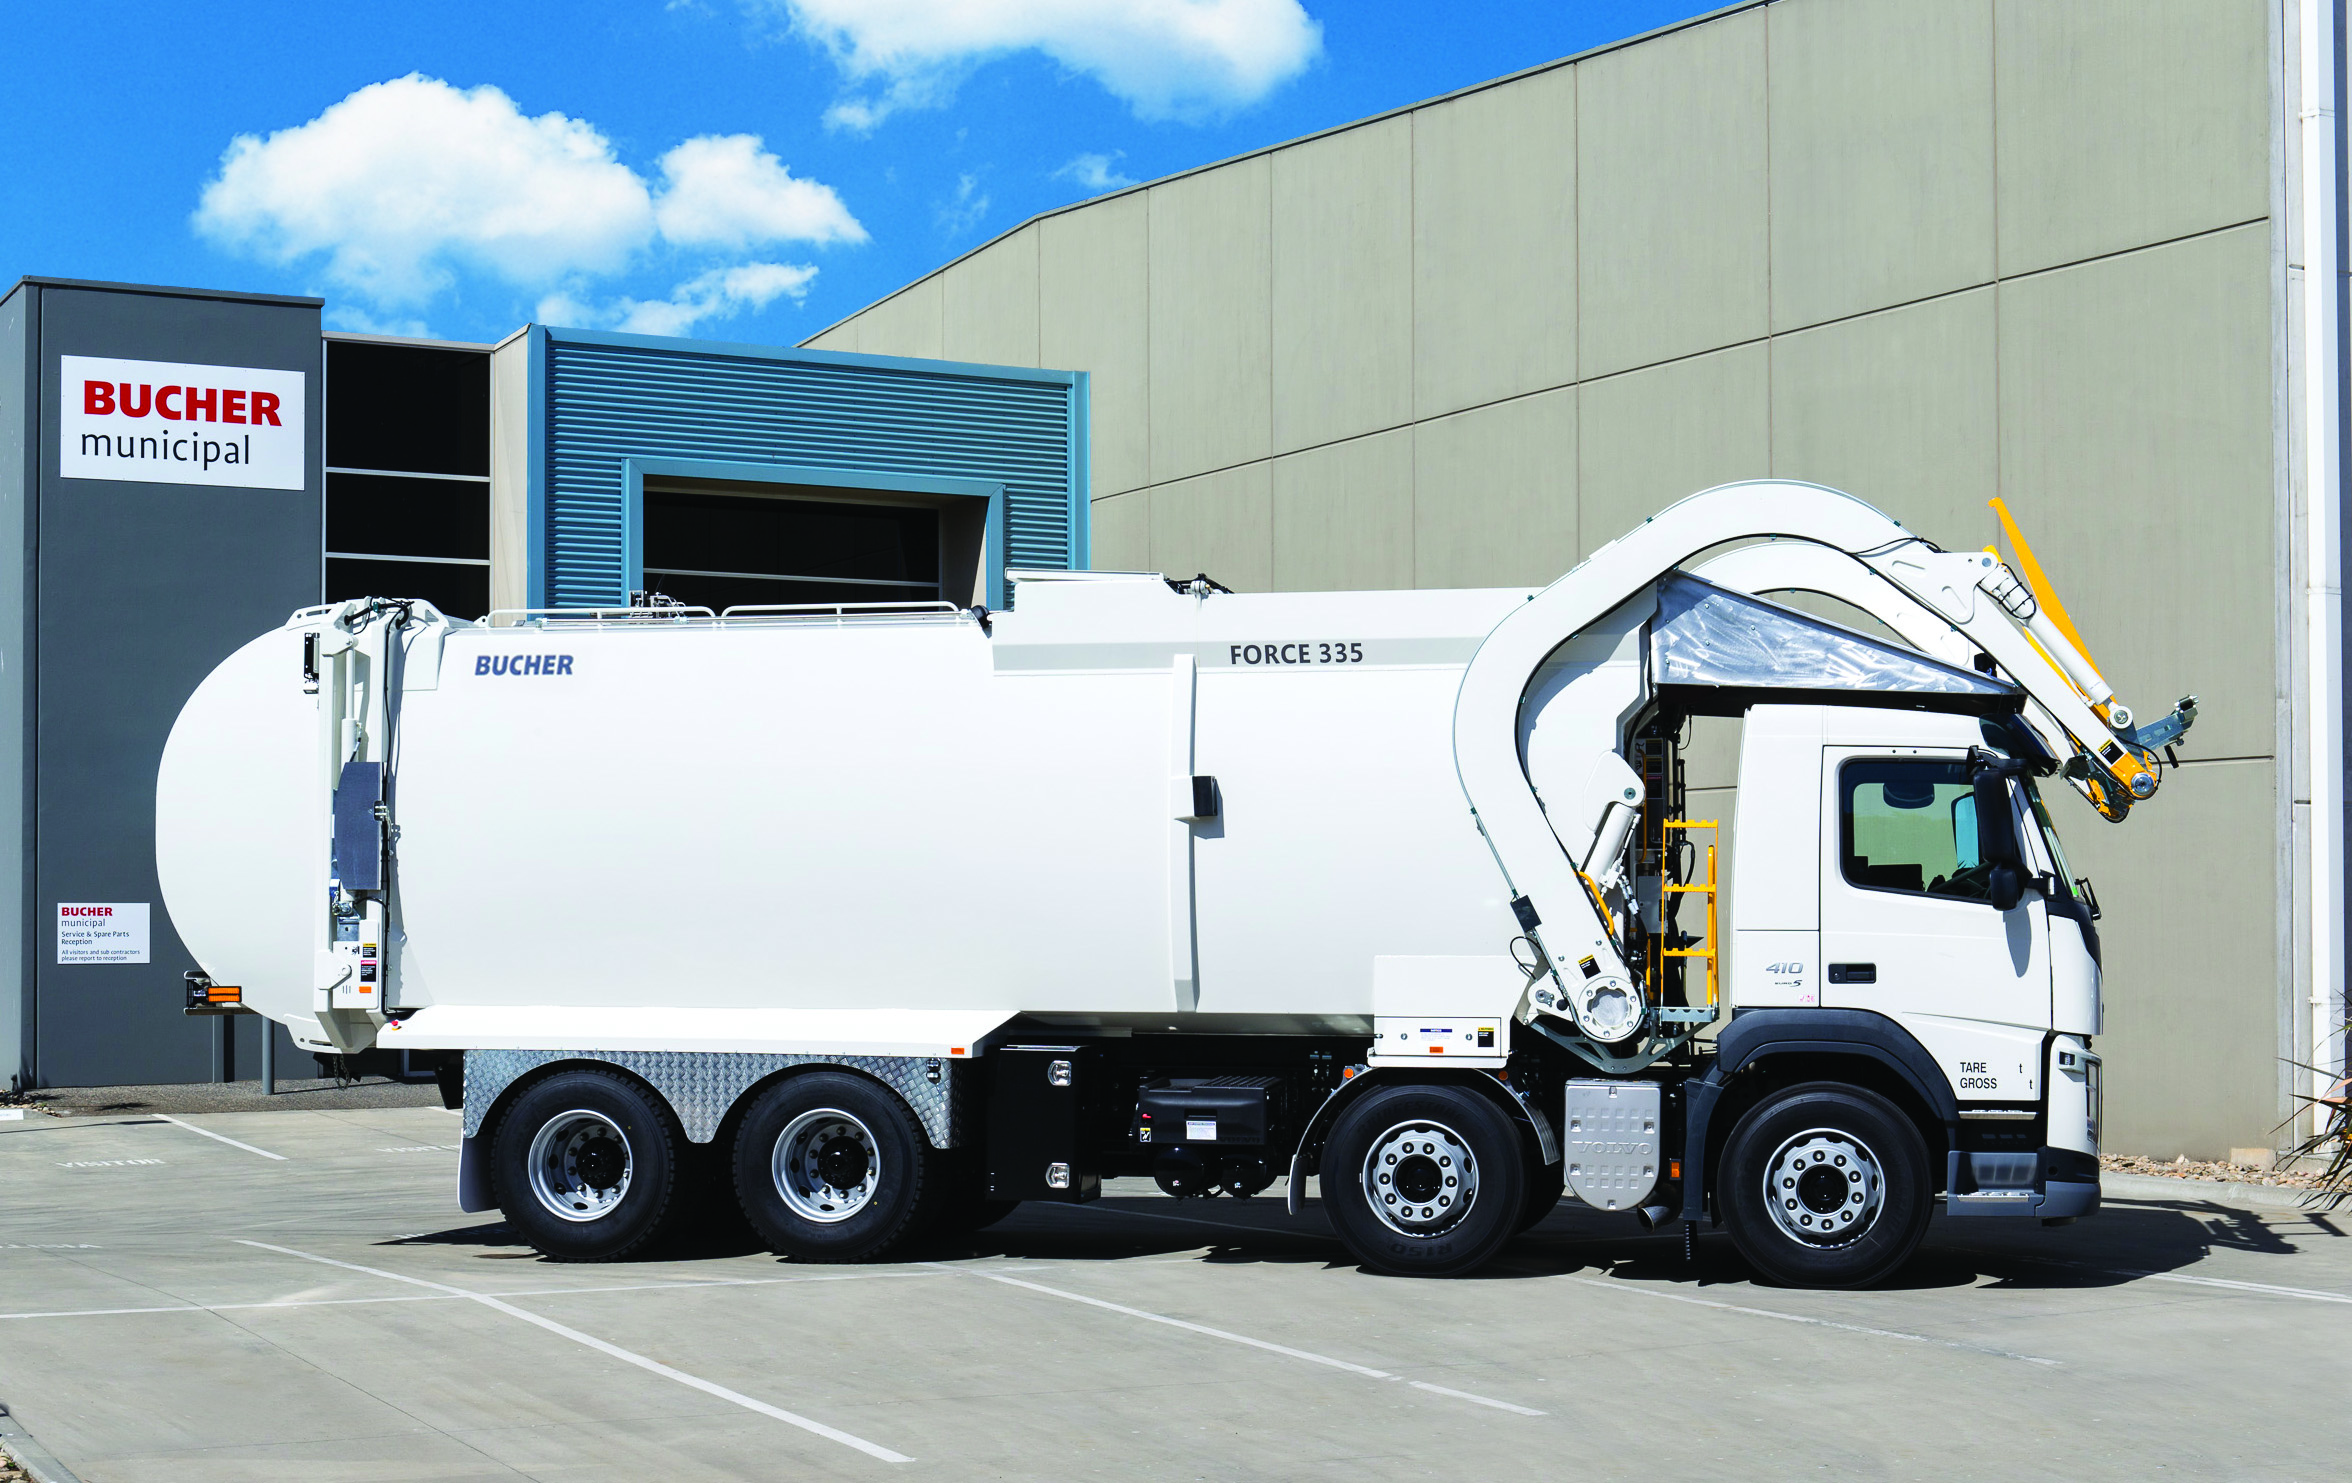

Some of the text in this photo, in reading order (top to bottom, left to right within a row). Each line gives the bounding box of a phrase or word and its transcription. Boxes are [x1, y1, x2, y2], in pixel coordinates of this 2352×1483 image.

[84, 380, 282, 427] BUCHER
[81, 429, 249, 471] municipal
[1230, 642, 1363, 665] FORCE 335
[474, 654, 574, 676] BUCHER
[61, 907, 113, 917] BUCHER
[61, 918, 106, 929] municipal
[93, 931, 112, 939] Spare
[61, 938, 93, 947] Reception
[1765, 962, 1804, 974] 410
[1959, 1062, 2023, 1074] TARE t
[1959, 1077, 2033, 1090] GROSS t
[1571, 1140, 1654, 1155] VOLVO
[55, 1158, 166, 1168] VISITOR
